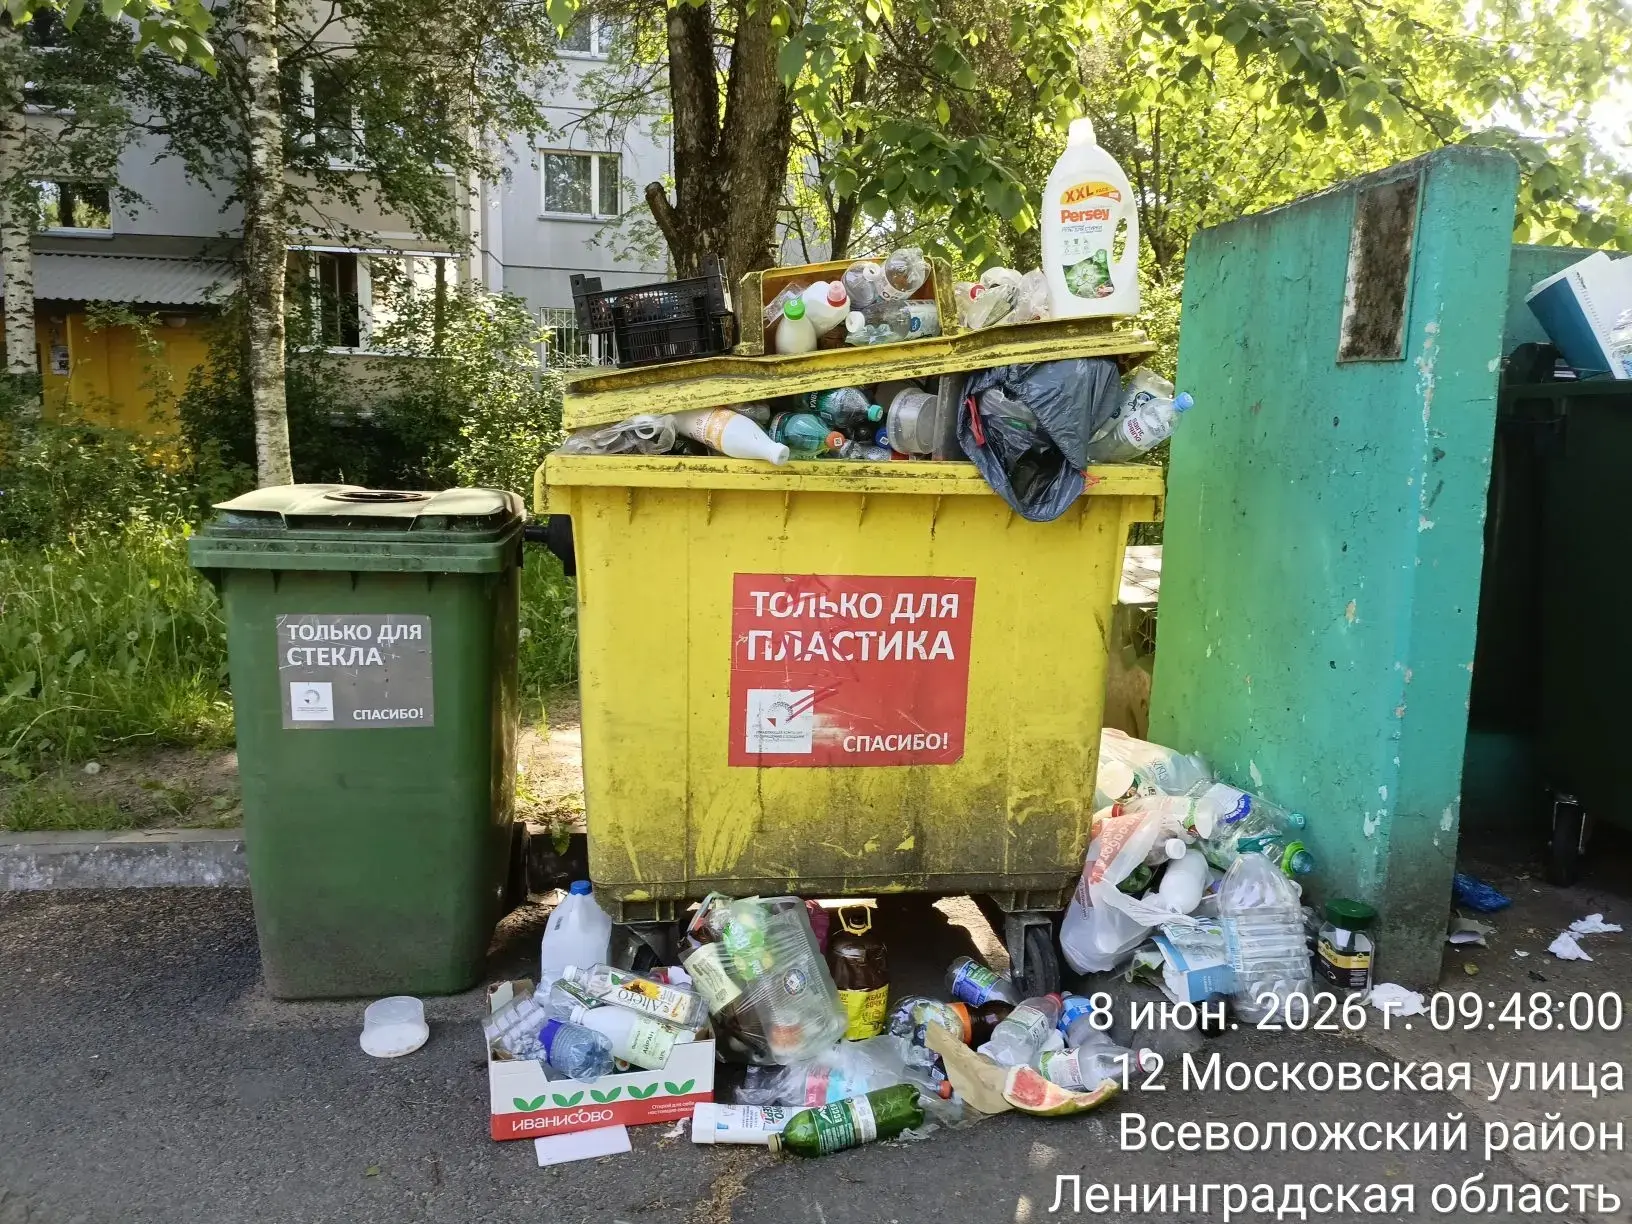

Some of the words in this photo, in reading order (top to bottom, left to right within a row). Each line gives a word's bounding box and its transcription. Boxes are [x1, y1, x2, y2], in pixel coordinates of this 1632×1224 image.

[1065, 186, 1094, 204] XXL
[1060, 208, 1110, 224] Persey
[750, 591, 883, 619] ТОЛЬКО
[890, 593, 959, 624] ДЛЯ
[286, 624, 372, 641] ТОЛЬКО
[377, 624, 422, 643] ДЛЯ
[747, 630, 955, 661] ПЛАСТИКА
[286, 647, 384, 666] СТЕКЛА
[353, 708, 424, 721] СПАСИБО!
[843, 732, 948, 753] СПАСИБО!
